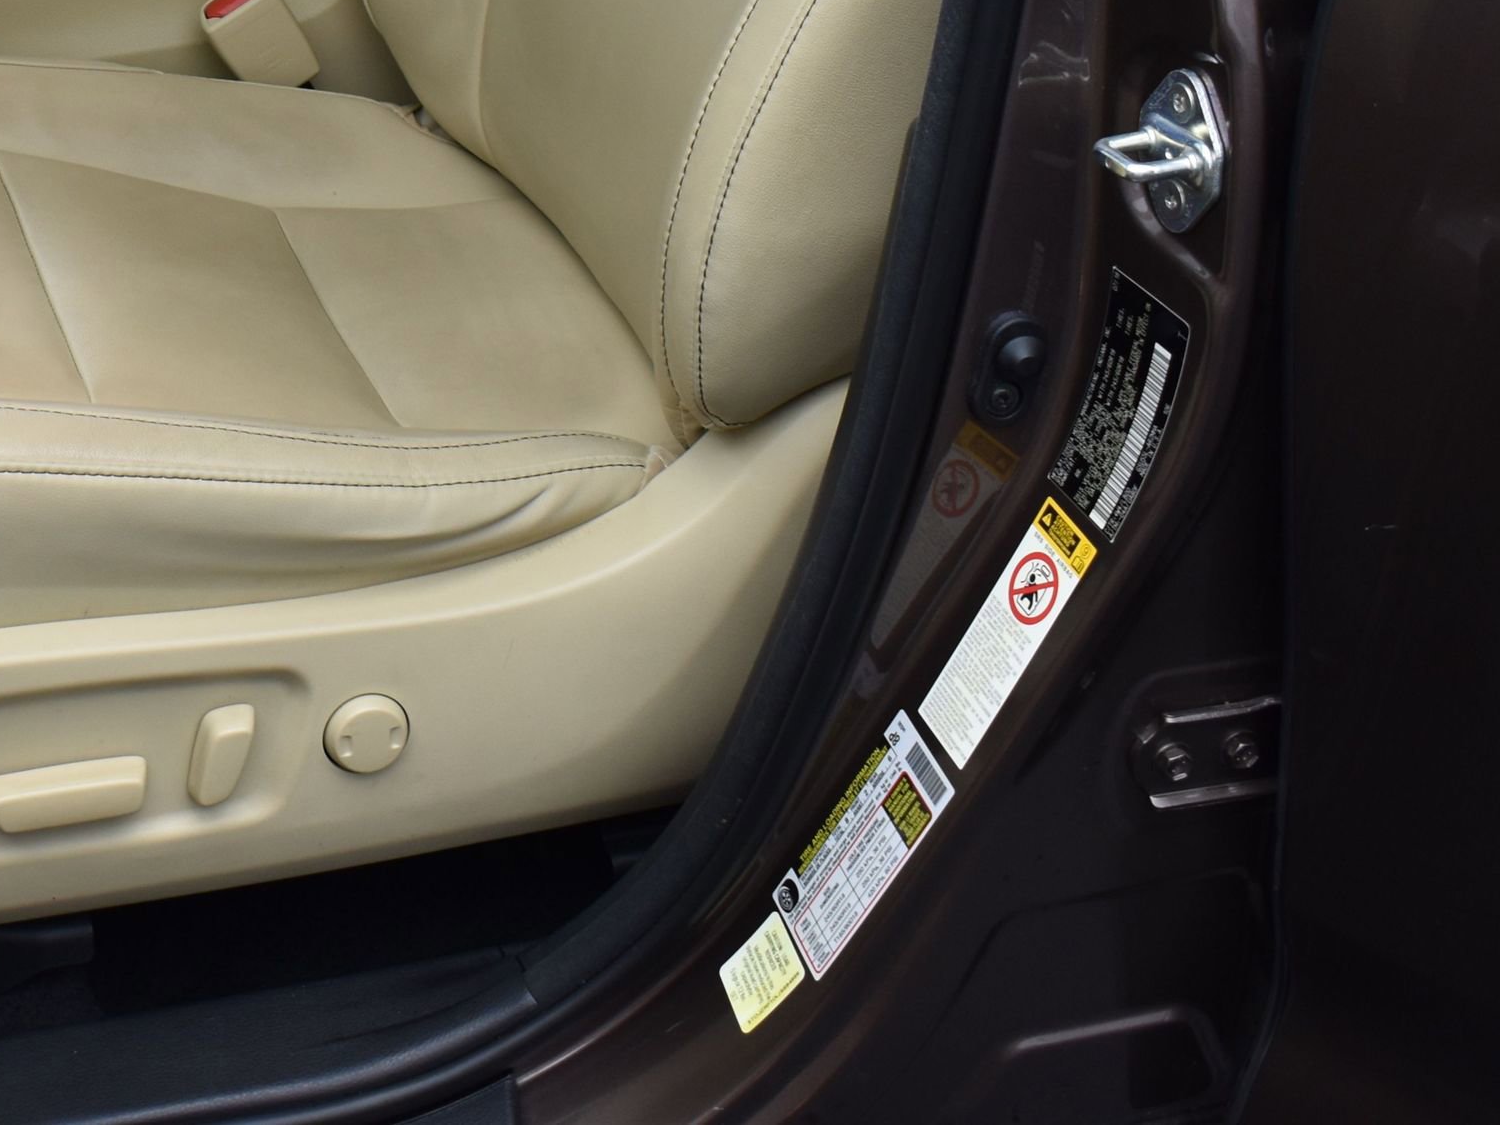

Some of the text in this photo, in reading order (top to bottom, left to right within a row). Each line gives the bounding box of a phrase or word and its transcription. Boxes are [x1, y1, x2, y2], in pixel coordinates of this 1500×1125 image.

[1055, 556, 1074, 579] AIRBAG
[798, 842, 813, 863] TIRE
[810, 826, 824, 847] AND
[821, 794, 846, 831] LOADING
[843, 745, 880, 798] INFORMATION
